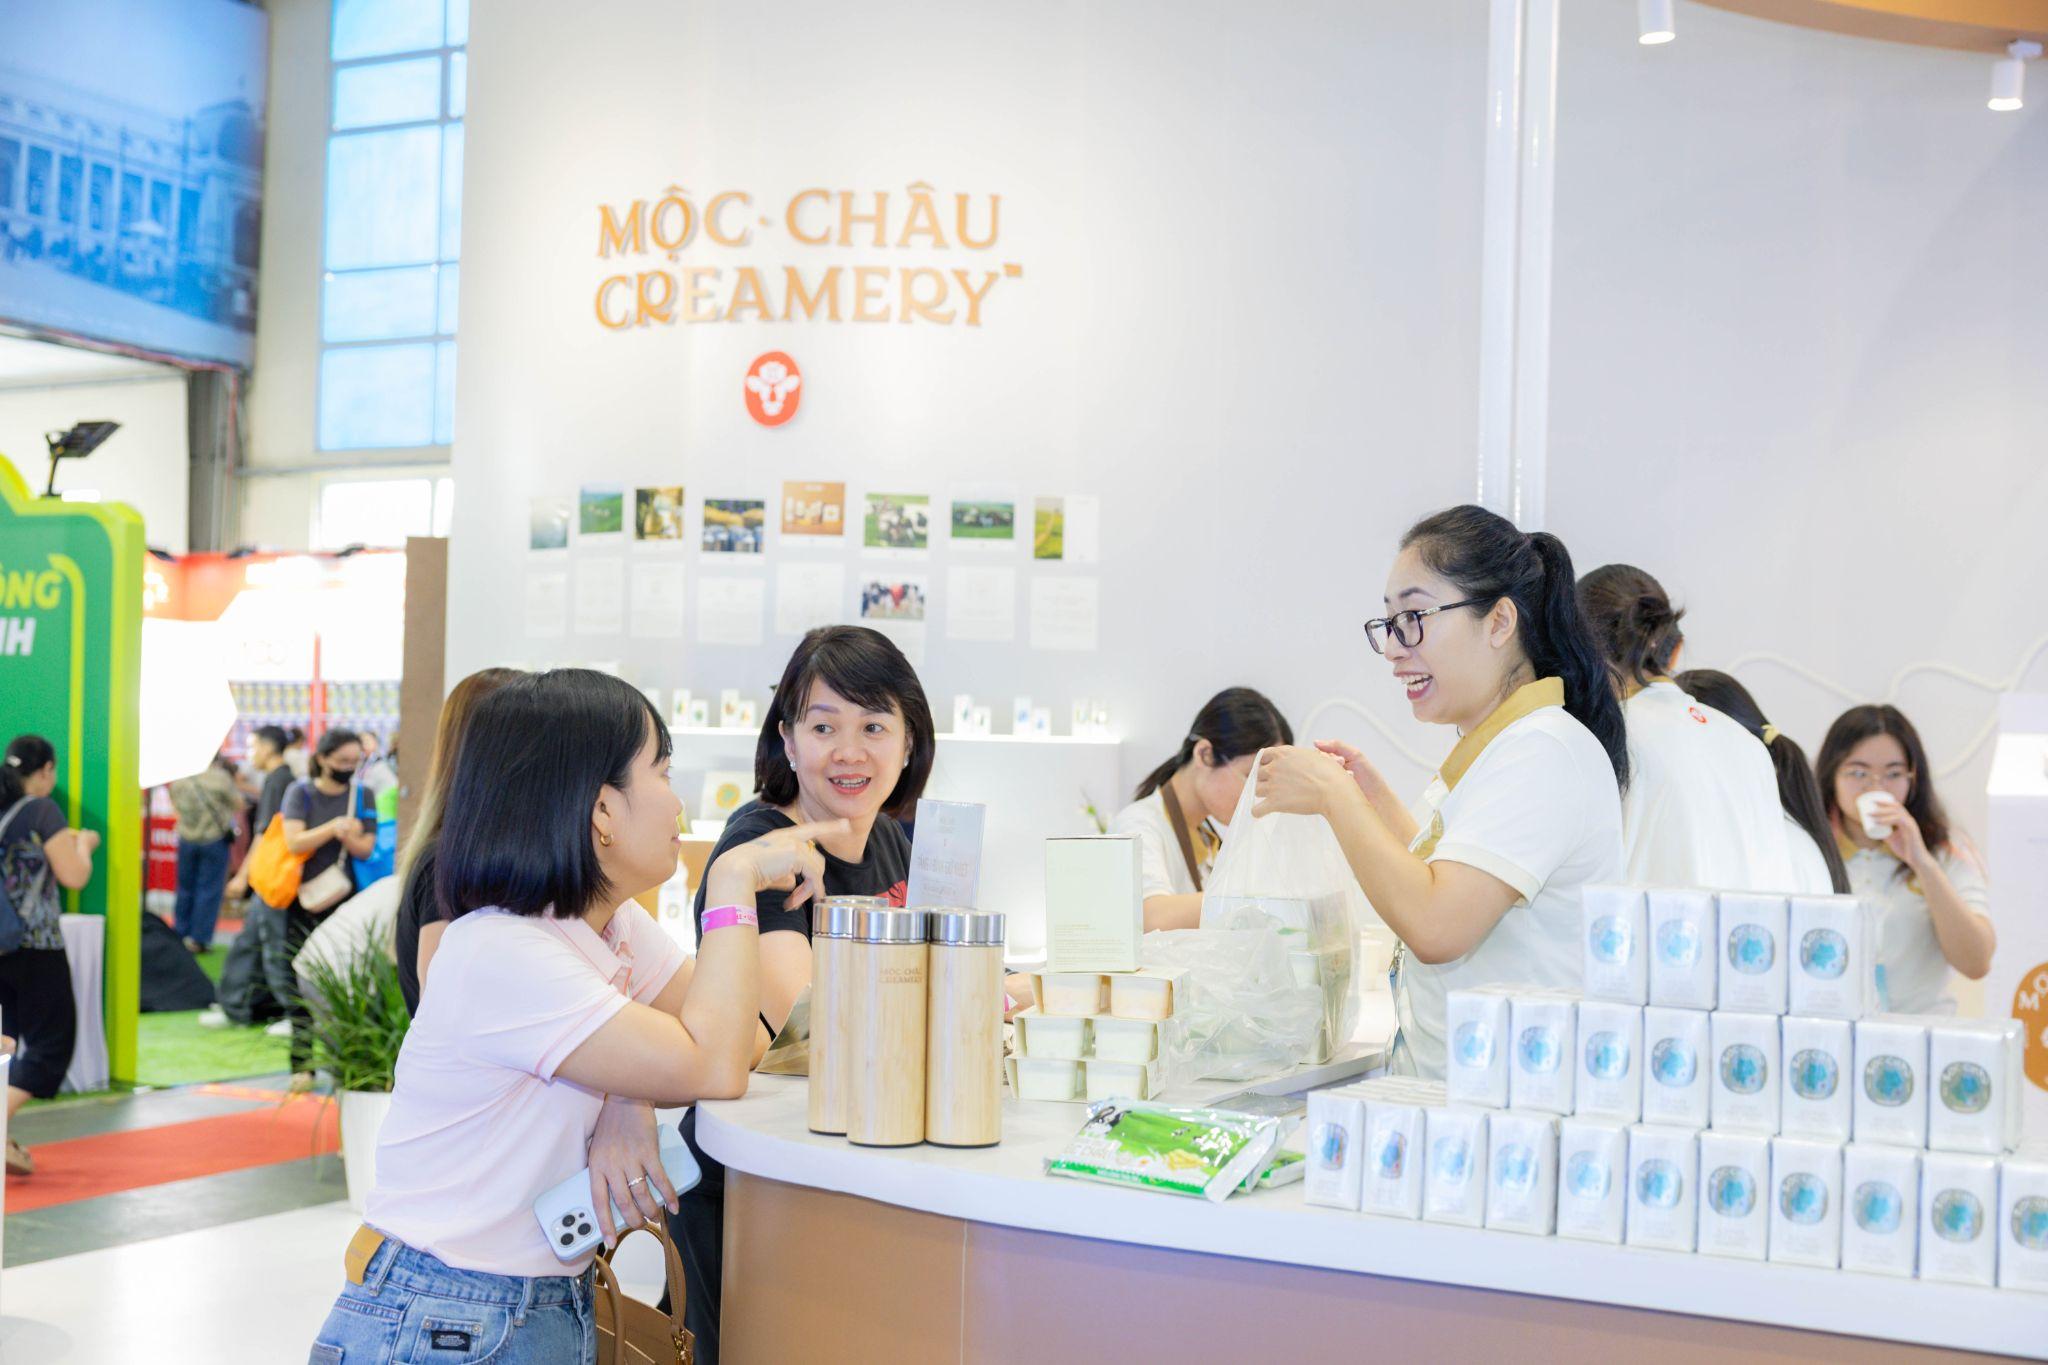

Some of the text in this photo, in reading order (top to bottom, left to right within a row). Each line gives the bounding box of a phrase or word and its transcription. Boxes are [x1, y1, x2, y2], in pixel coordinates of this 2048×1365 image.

[597, 180, 1001, 261] MỘC CHÂU
[0, 562, 62, 610] NG
